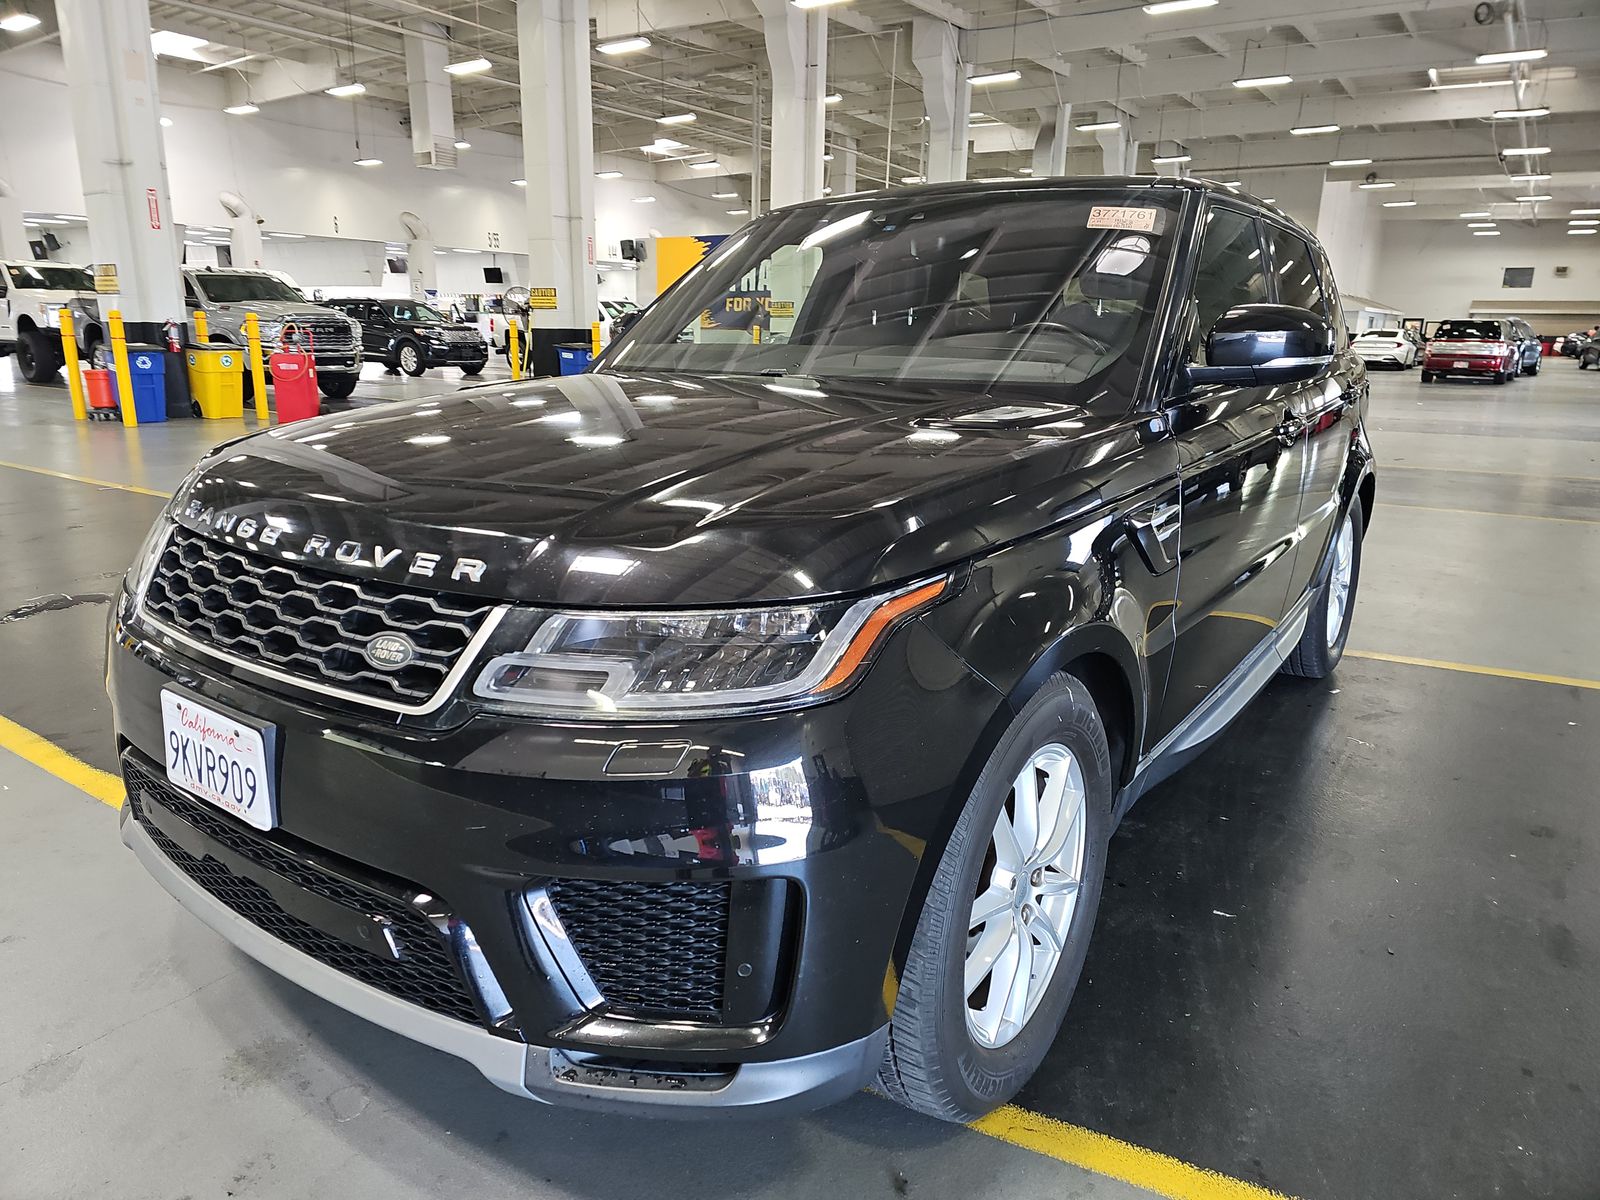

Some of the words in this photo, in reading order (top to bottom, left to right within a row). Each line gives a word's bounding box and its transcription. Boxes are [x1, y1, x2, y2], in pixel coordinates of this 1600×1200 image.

[1092, 208, 1154, 220] 3771761
[531, 288, 556, 297] CAUTION
[725, 298, 752, 312] FOR
[184, 499, 283, 546] RANGE
[303, 533, 487, 583] ROVER
[374, 648, 404, 663] ROVER
[180, 706, 243, 753] California
[169, 730, 257, 809] 9KVR909
[189, 782, 242, 813] dmv.ca.gov
